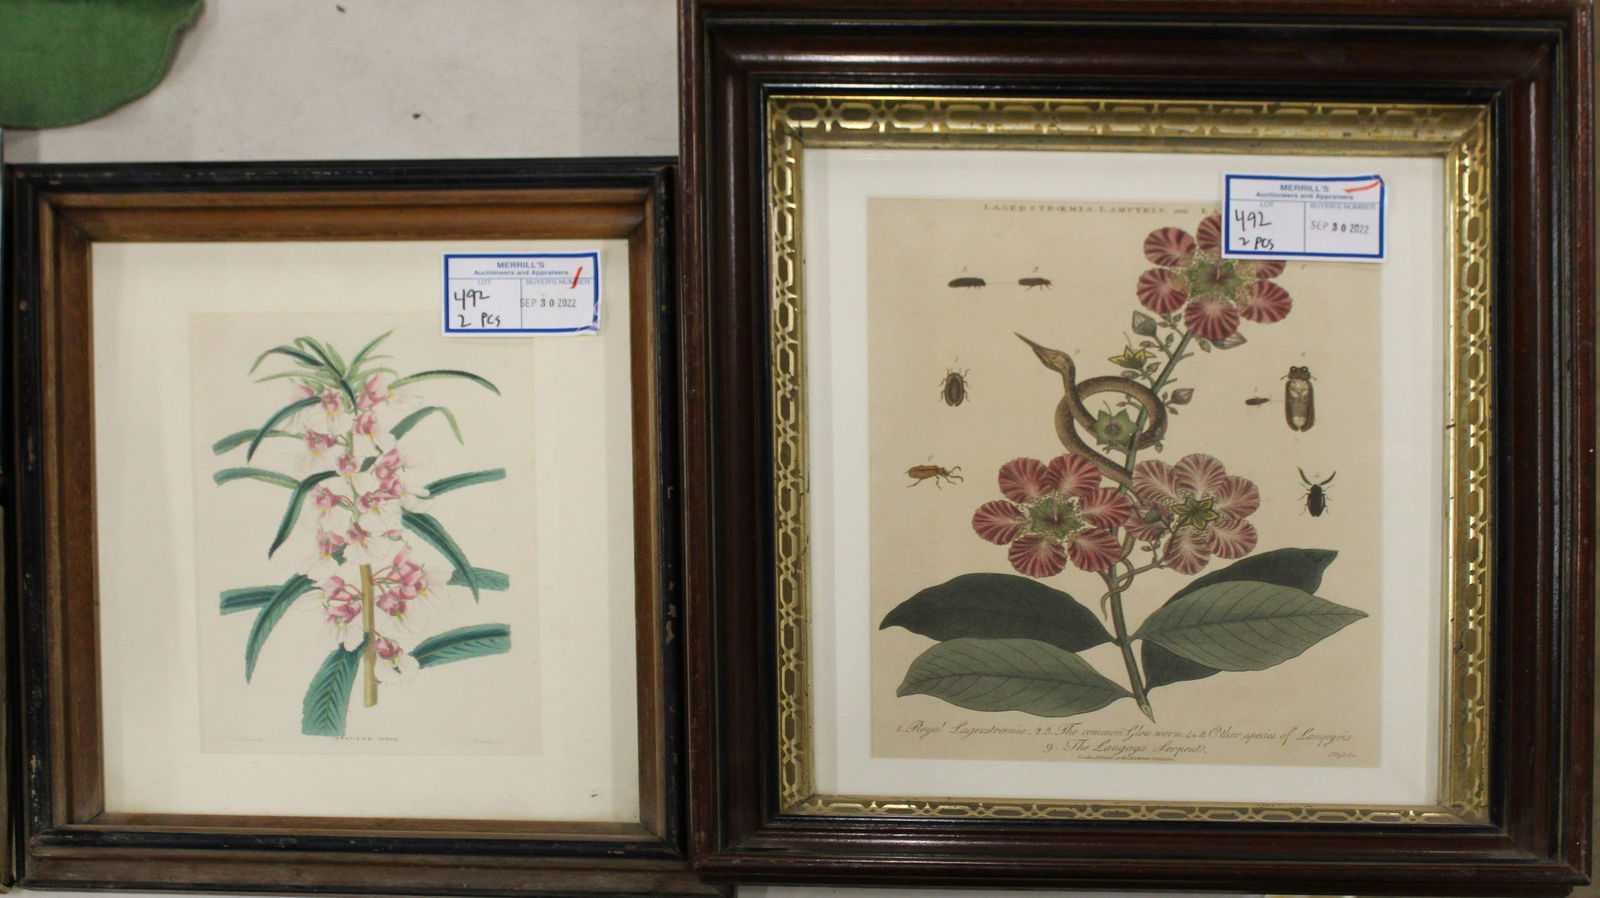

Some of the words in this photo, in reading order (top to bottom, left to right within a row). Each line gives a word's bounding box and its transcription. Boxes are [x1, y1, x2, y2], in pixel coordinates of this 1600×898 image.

[1280, 183, 1330, 193] MERRILL'S
[1255, 191, 1299, 199] Auctioneers
[1315, 193, 1354, 201] Appraisers
[1343, 202, 1376, 210] NUMBER
[1234, 209, 1272, 232] 492
[1311, 220, 1329, 231] SEP
[1349, 223, 1371, 235] 2022
[1238, 236, 1250, 247] 2
[1254, 236, 1275, 251] PCS
[496, 261, 545, 269] MERRILL'S
[525, 278, 557, 286] BUYER'S
[453, 289, 490, 310] 492
[519, 298, 537, 309] SEP
[557, 298, 577, 308] 2022
[457, 314, 473, 328] 2
[481, 312, 501, 328] PCS
[1240, 729, 1276, 745] species
[1280, 726, 1299, 746] of
[1063, 738, 1090, 752] The
